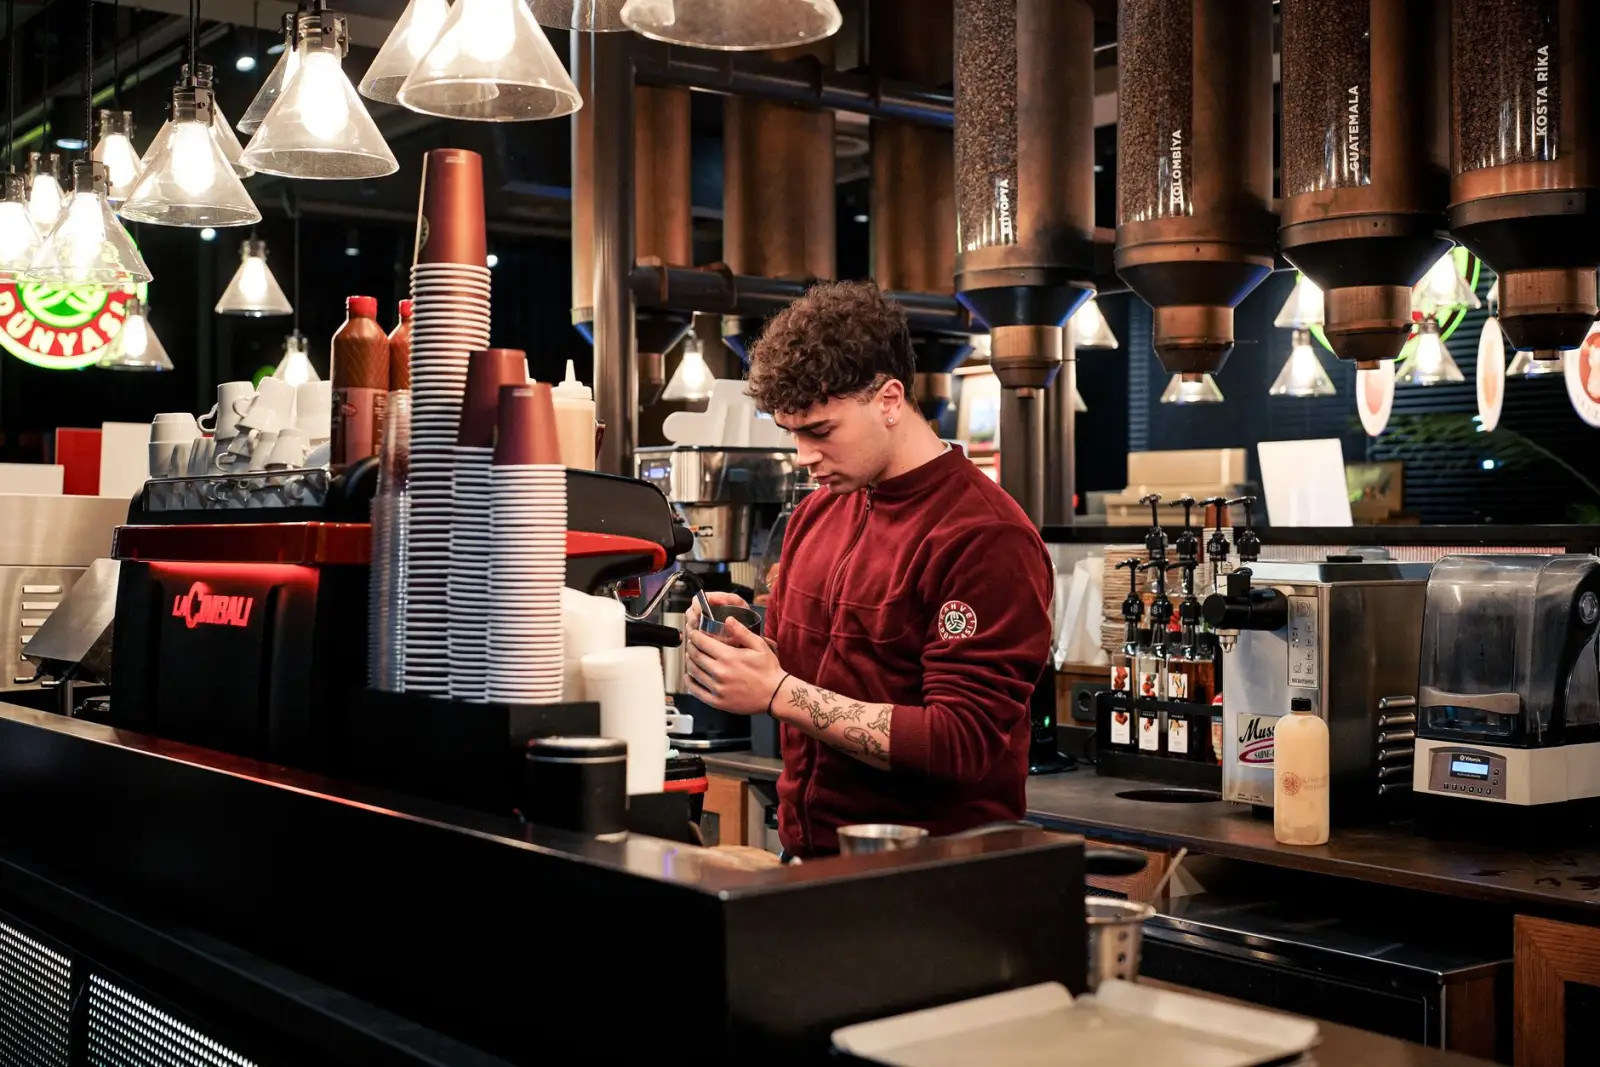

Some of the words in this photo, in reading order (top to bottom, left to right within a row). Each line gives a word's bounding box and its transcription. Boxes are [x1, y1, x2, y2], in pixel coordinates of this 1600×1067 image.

[1348, 85, 1359, 172] GUATEMALA
[1535, 86, 1548, 137] KOSTA
[1170, 129, 1182, 205] KOLOMBİYA
[940, 602, 973, 620] KAHVE
